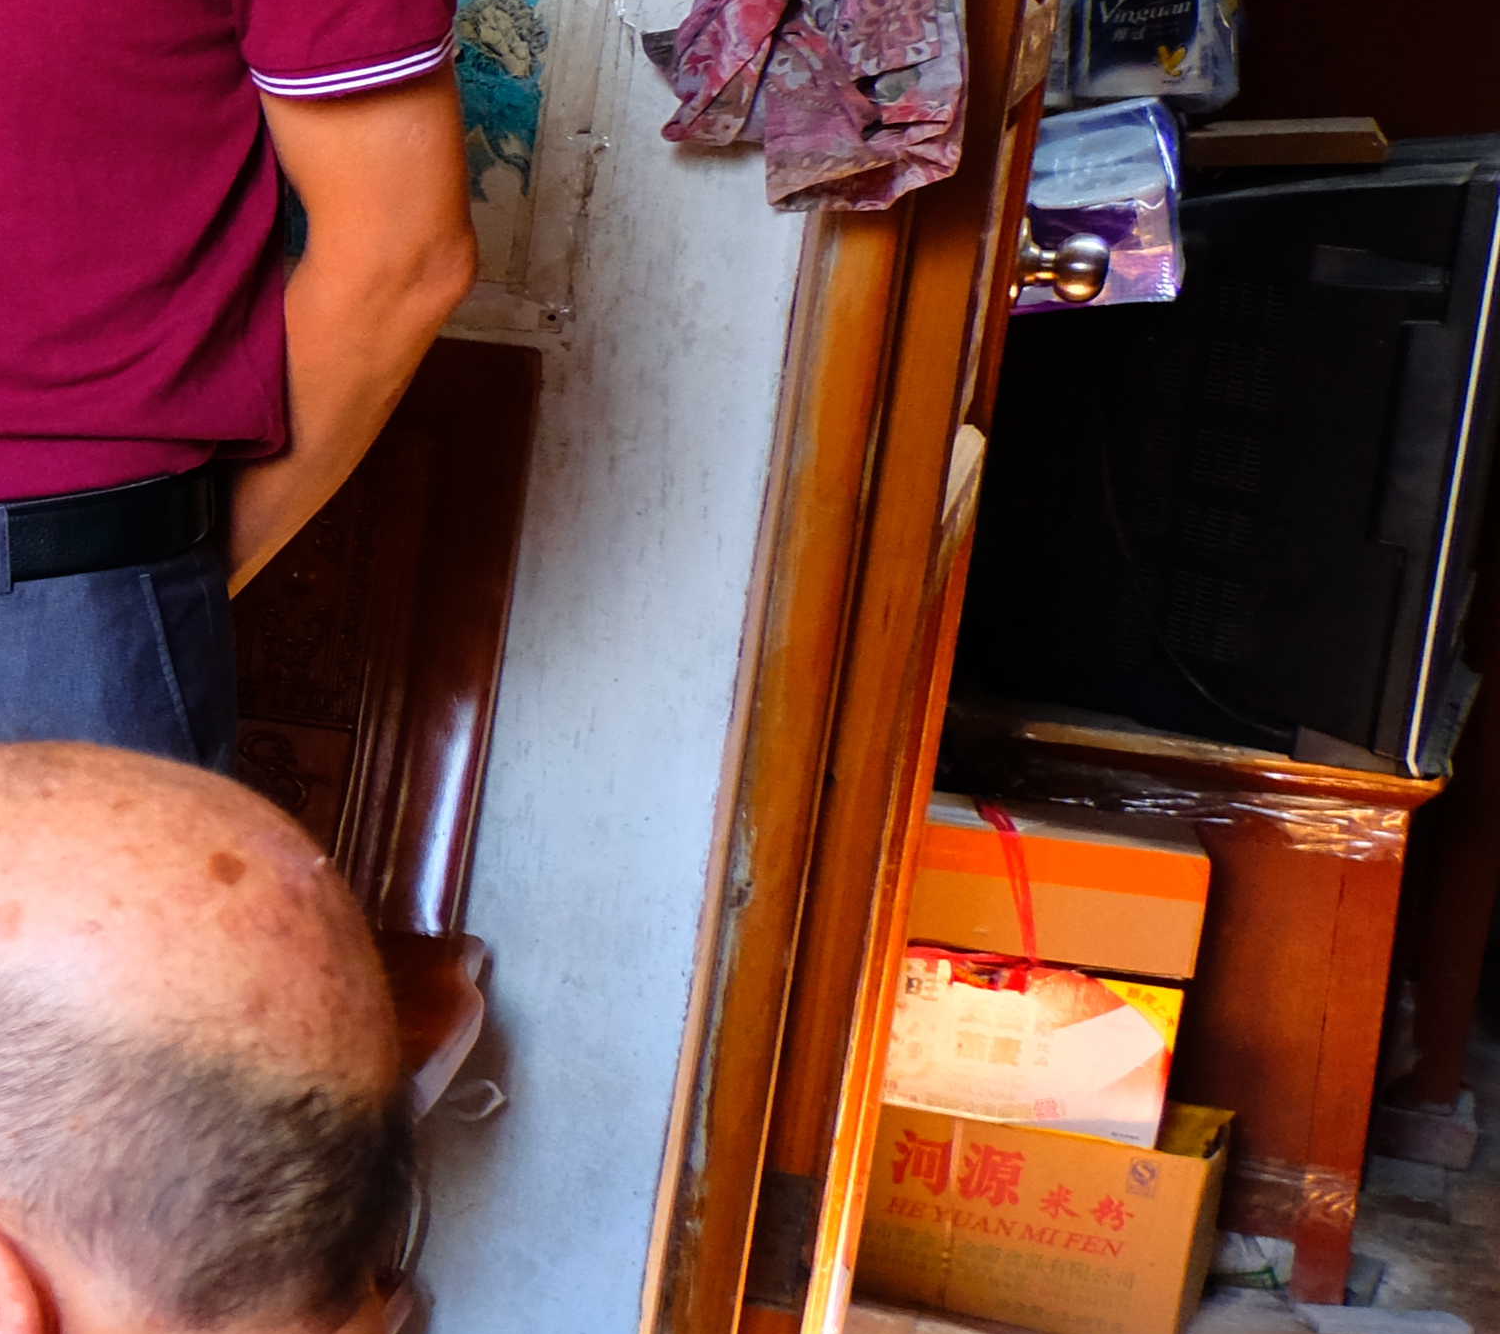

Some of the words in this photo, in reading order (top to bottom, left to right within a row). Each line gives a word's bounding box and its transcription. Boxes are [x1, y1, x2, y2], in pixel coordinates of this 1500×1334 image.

[892, 1129, 1026, 1207] 河源
[1039, 1183, 1135, 1231] 米粉
[887, 1197, 924, 1220] HE
[932, 1205, 1018, 1237] YUAN
[1019, 1221, 1062, 1244] MI
[1061, 1233, 1125, 1257] FEN
